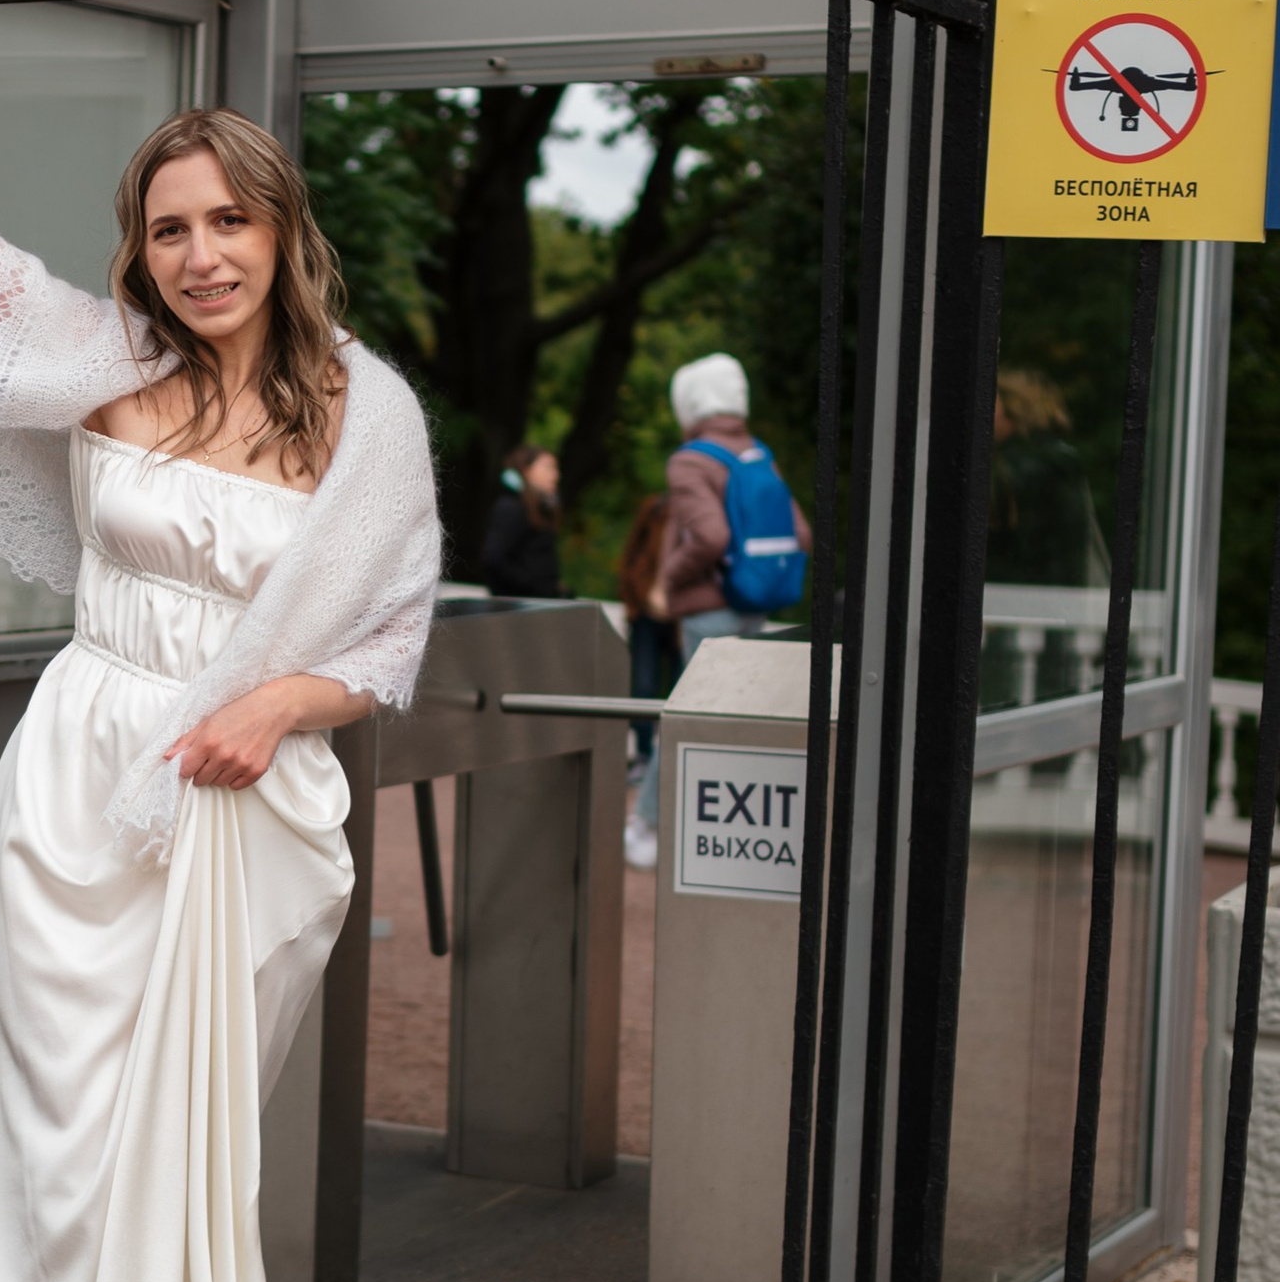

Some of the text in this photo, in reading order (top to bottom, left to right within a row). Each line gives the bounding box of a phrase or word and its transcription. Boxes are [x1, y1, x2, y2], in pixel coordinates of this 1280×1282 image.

[1053, 178, 1198, 198] БЕСПОЛЁТНАЯ
[1096, 205, 1151, 222] ЗОНА
[697, 779, 799, 828] EXIT
[696, 834, 797, 867] ВЫХОД
